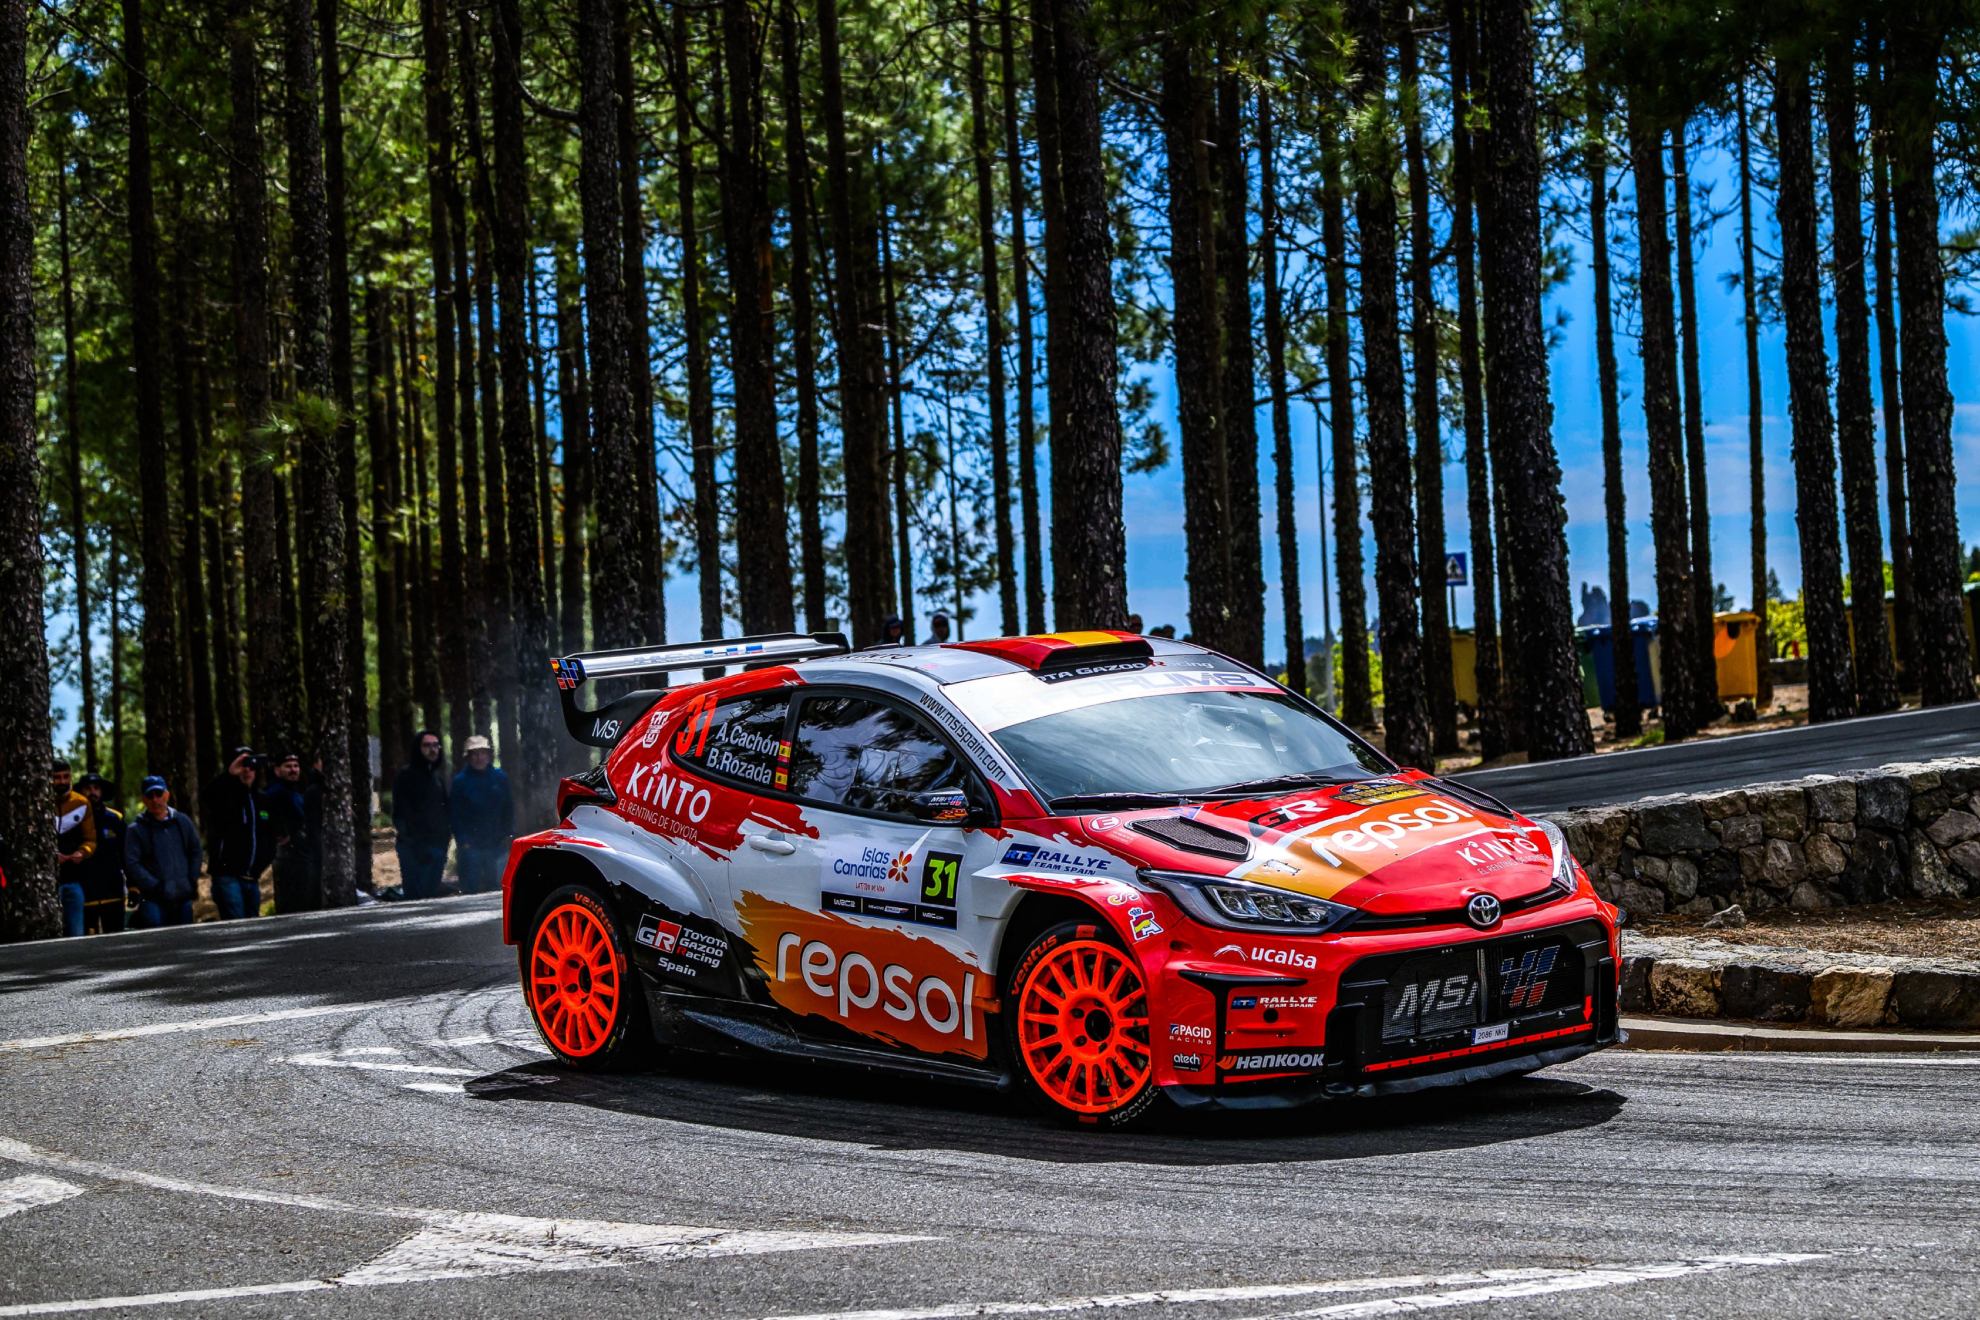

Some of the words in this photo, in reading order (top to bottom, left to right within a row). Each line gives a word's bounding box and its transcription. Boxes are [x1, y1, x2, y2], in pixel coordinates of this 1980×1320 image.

[1075, 662, 1147, 675] GAZOO
[1148, 660, 1215, 669] Racing
[675, 694, 719, 757] 31
[919, 692, 1007, 781] www.msispain.com
[715, 721, 780, 757] A.Cachón
[706, 747, 773, 785] B.Rozada
[617, 798, 627, 812] EL
[626, 801, 658, 825] RENTING
[657, 815, 670, 830] DE
[669, 819, 698, 841] TOYOTA
[1310, 799, 1475, 869] repsol
[861, 846, 891, 865] Islas
[1005, 849, 1035, 861] RTS
[1036, 850, 1111, 871] RALLYE
[833, 858, 887, 880] Canarias
[925, 858, 958, 899] 31
[1034, 861, 1061, 871] TEAM
[1064, 866, 1096, 876] SPAIN
[638, 926, 676, 951] GR
[683, 927, 728, 950] TOYOTA
[679, 937, 724, 957] GAZOO
[657, 956, 697, 977] Spain
[676, 946, 721, 968] Racing
[1251, 947, 1317, 969] ucalsa
[775, 932, 974, 1041] repsol
[1259, 996, 1318, 1004] RALLYE
[1169, 1035, 1212, 1045] RACING
[1180, 1024, 1212, 1039] PAGID
[1173, 1052, 1201, 1065] atech
